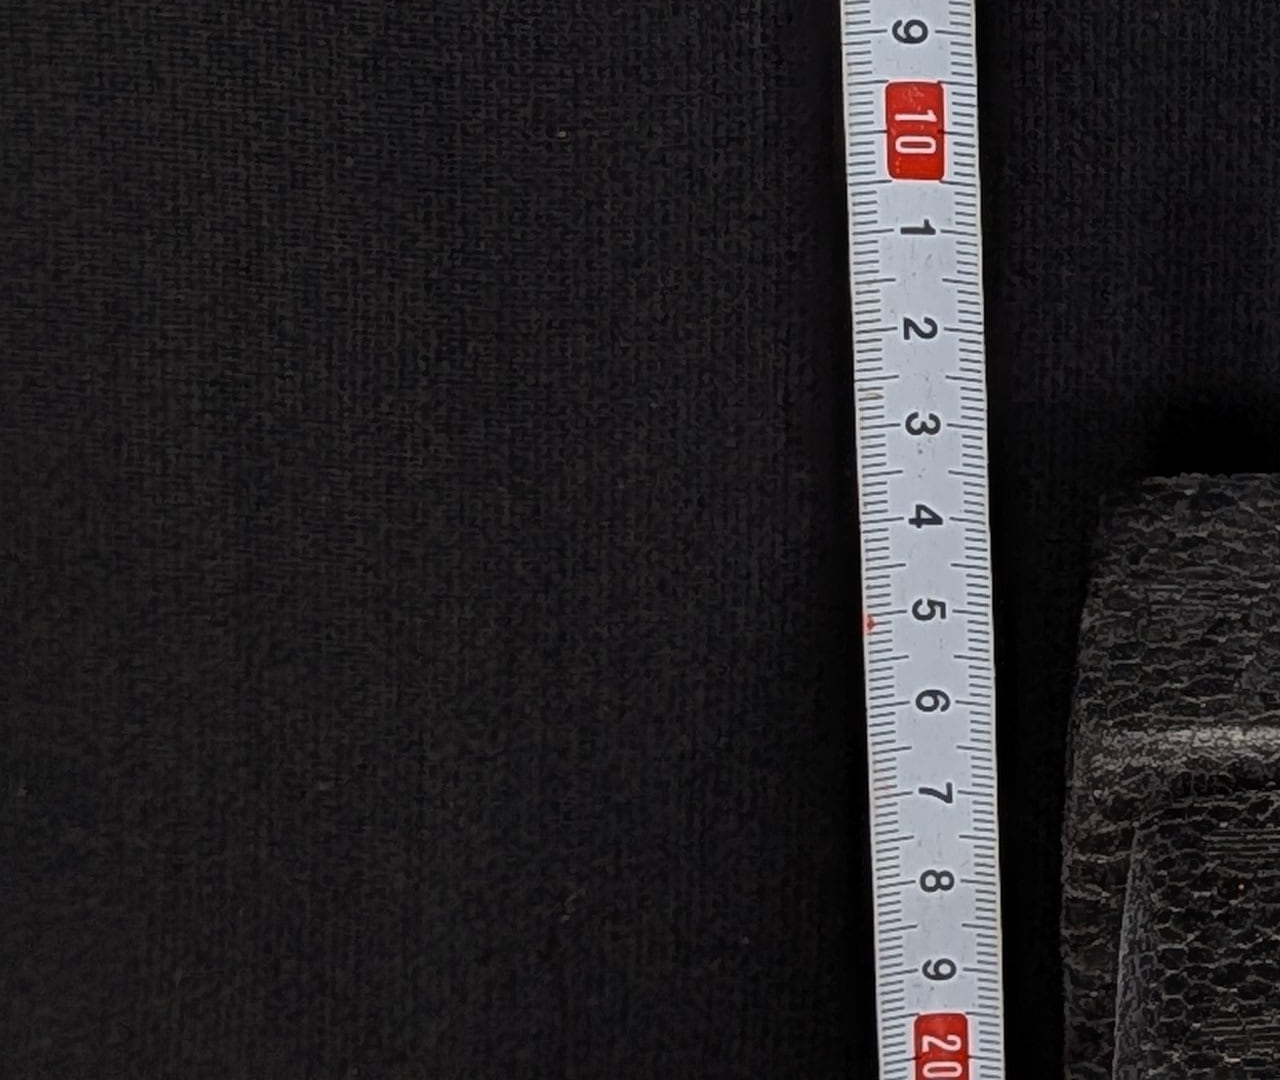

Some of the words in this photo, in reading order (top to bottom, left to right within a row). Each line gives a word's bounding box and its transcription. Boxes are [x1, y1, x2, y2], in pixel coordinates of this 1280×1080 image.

[891, 19, 929, 45] 9
[894, 109, 938, 154] 10
[900, 219, 936, 236] 1
[903, 317, 938, 341] 2
[905, 412, 941, 436] 3
[908, 504, 943, 529] 4
[911, 598, 947, 622] 5
[915, 689, 951, 713] 6
[918, 782, 953, 804] 7
[919, 869, 955, 893] 8
[921, 958, 957, 981] 9
[922, 1034, 962, 1078] 20
